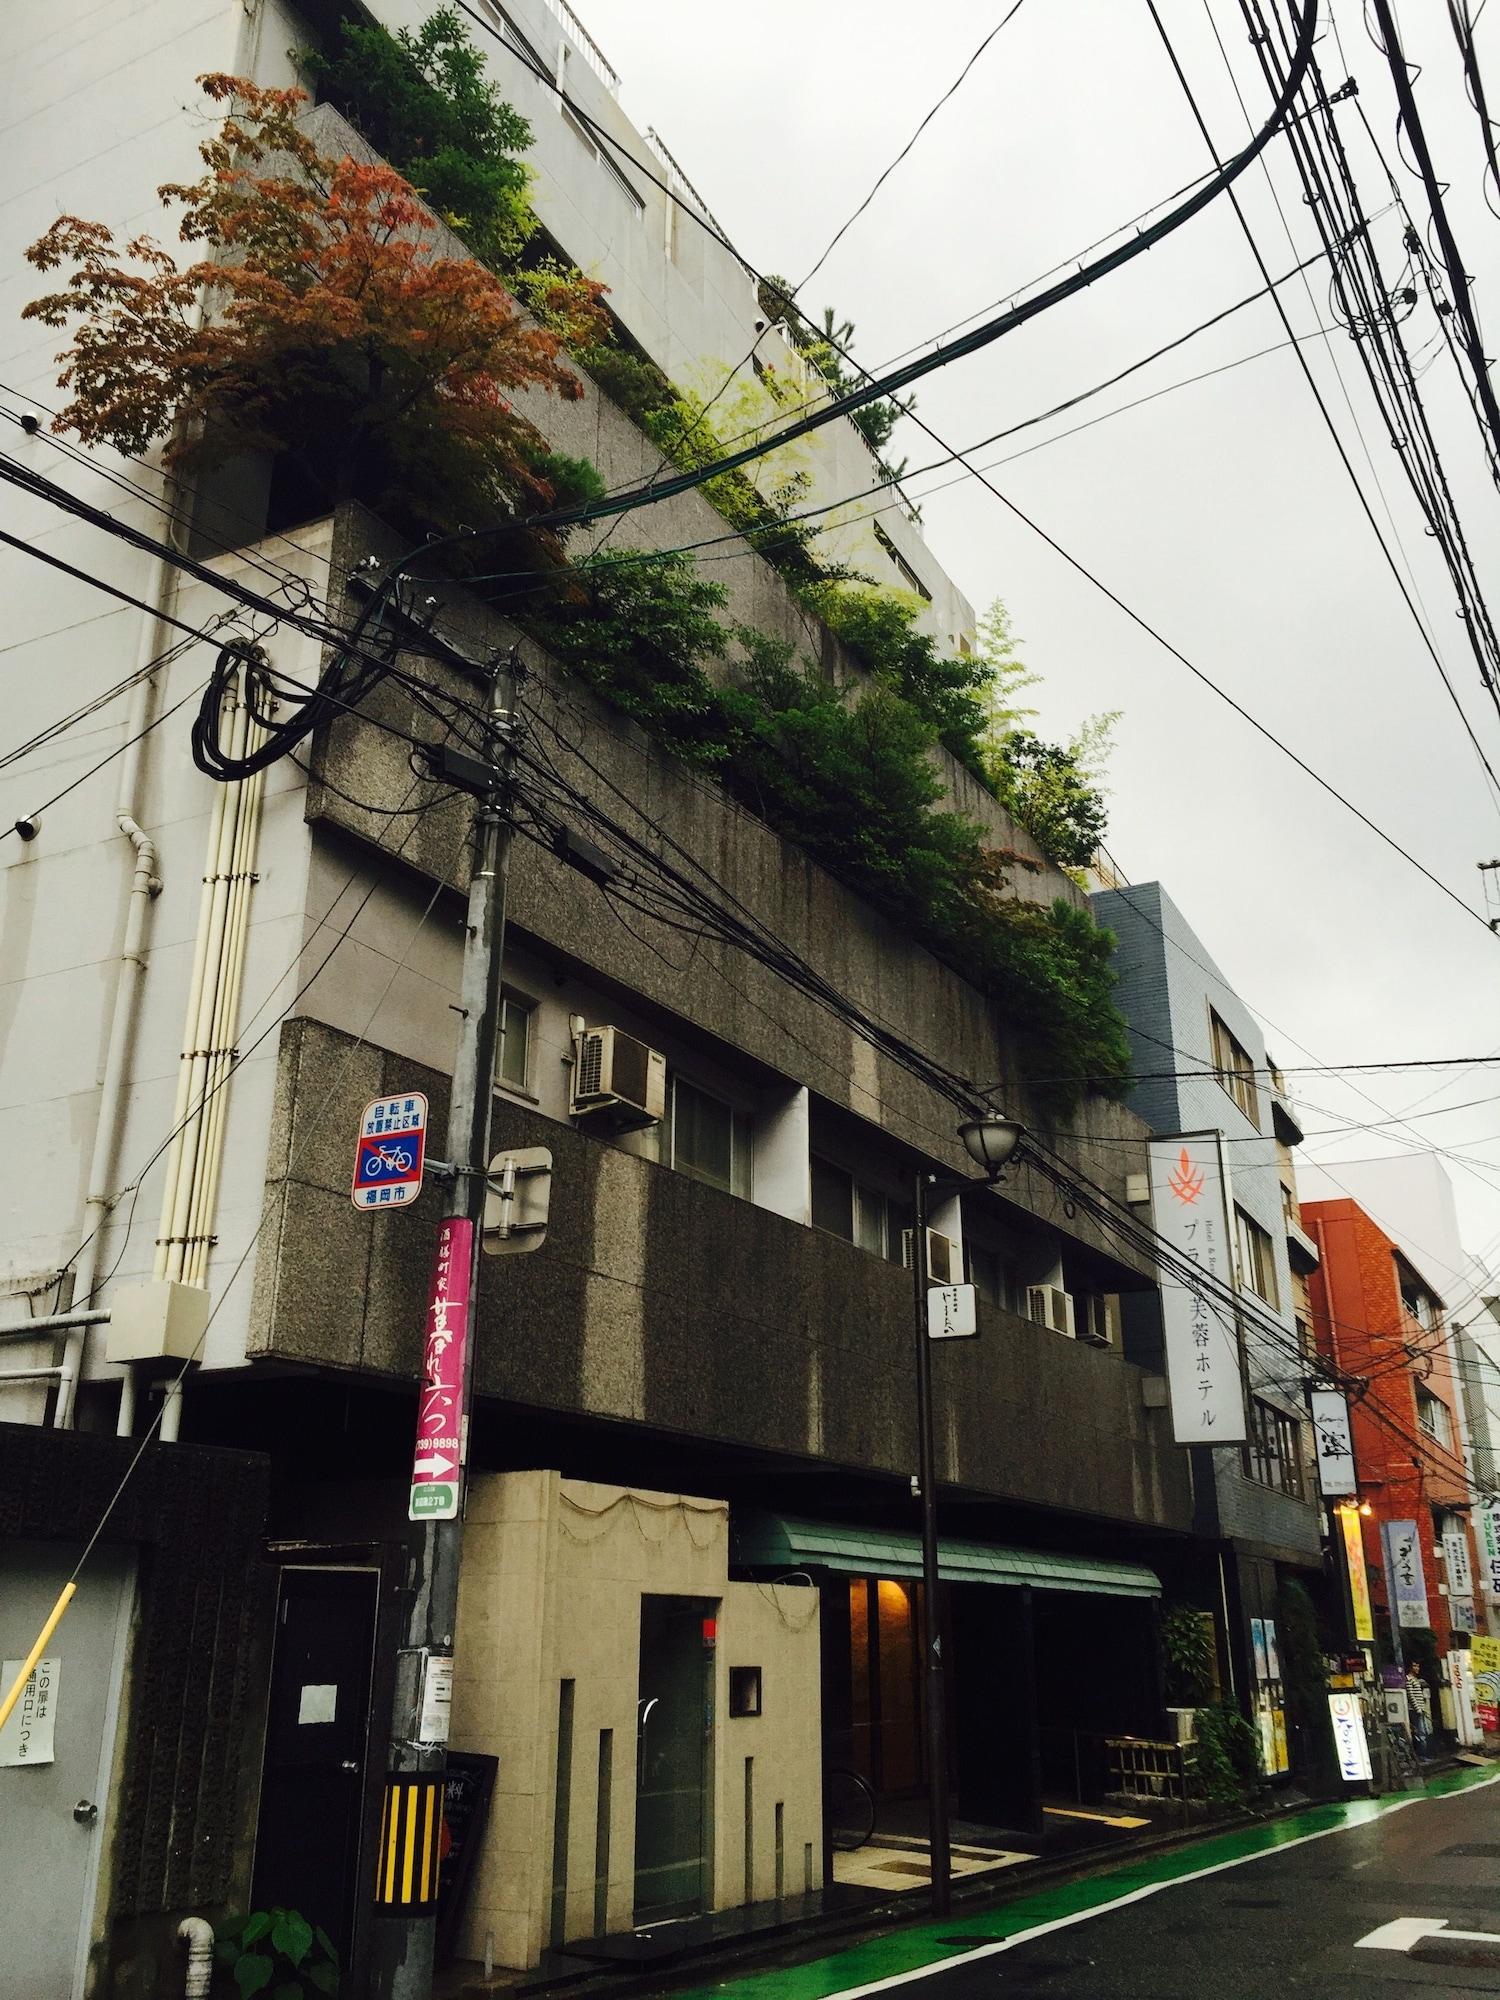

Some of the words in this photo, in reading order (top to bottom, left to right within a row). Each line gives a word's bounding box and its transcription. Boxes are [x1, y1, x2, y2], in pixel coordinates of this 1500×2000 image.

[374, 1099, 415, 1119] 自転車
[366, 1113, 420, 1135] 放置禁止区域
[365, 1186, 406, 1204] 福岡市
[36, 1662, 51, 1719] この扉は
